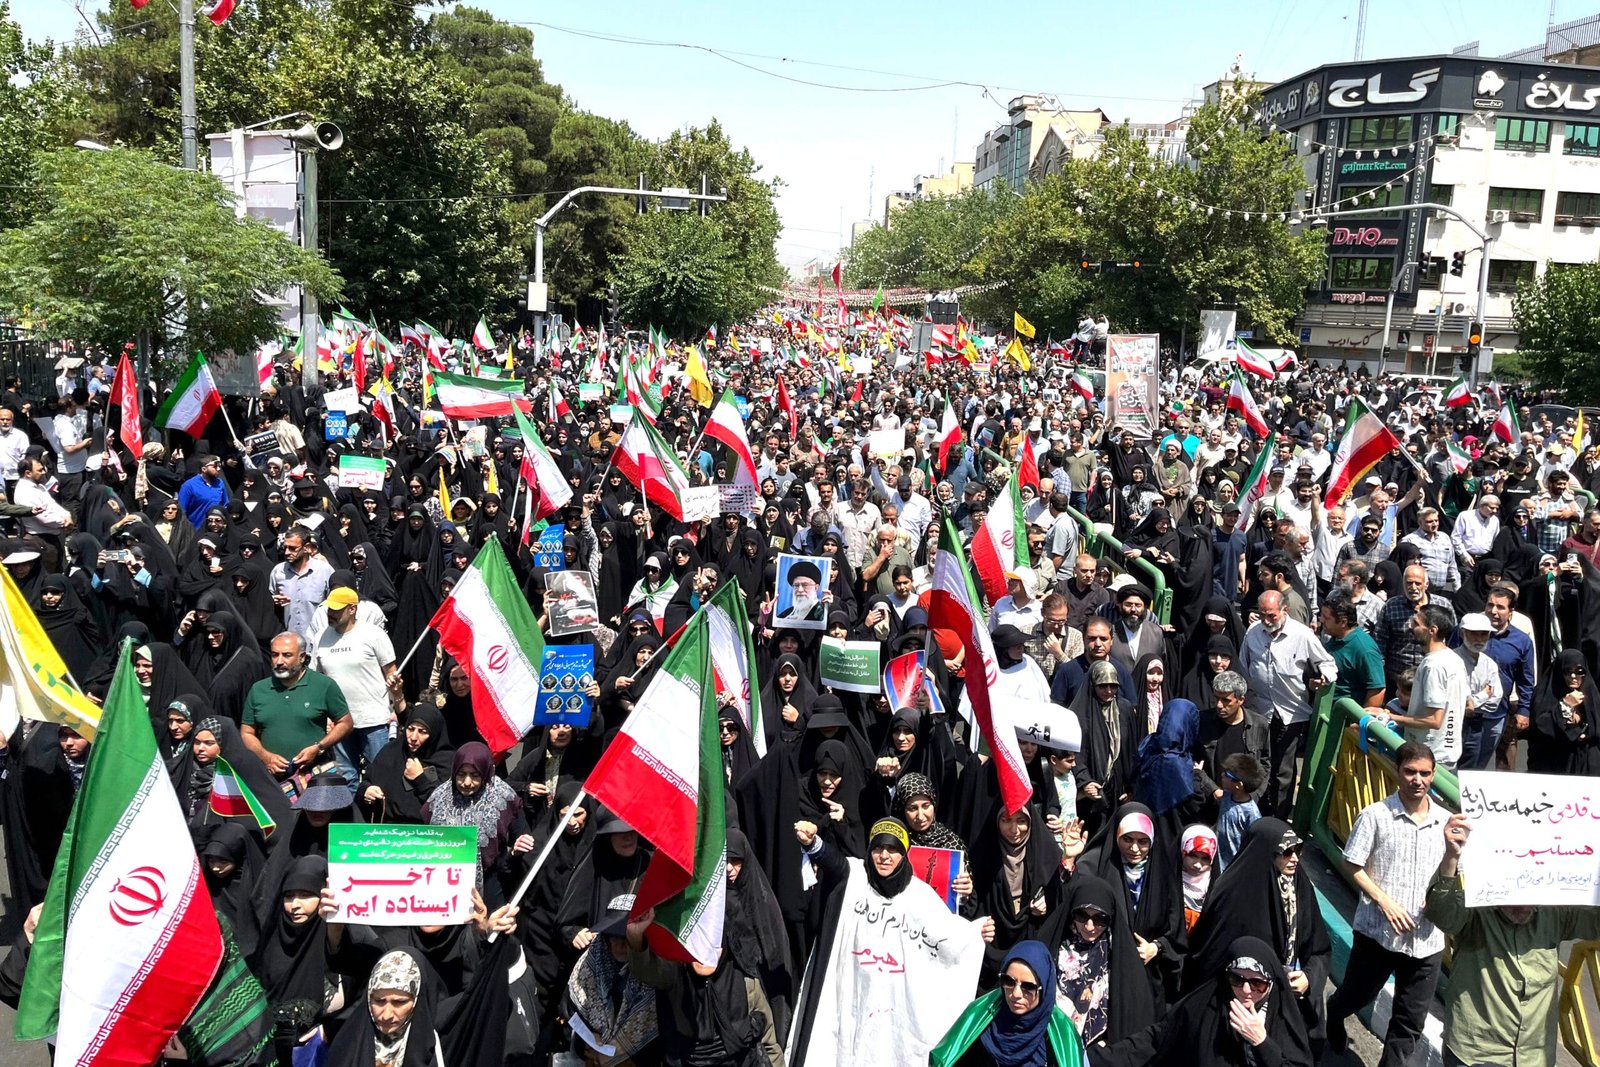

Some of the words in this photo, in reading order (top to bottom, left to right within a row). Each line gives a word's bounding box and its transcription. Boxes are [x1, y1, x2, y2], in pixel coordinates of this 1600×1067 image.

[1328, 67, 1441, 108] گاج
[1341, 161, 1406, 173] gajmarket.com
[1327, 337, 1349, 347] ادیب
[1350, 329, 1384, 346] کتاب
[1461, 785, 1508, 819] معاویه
[1509, 792, 1554, 824] خیمه
[1548, 796, 1591, 824] قدمی
[1515, 836, 1594, 865] هستیم
[342, 866, 436, 893] آخر
[446, 866, 462, 886] تا
[346, 894, 378, 919] ایم
[385, 894, 458, 918] ایستاده
[867, 902, 892, 924] آن
[882, 912, 909, 938] دارم
[851, 948, 905, 974] رهبرم
